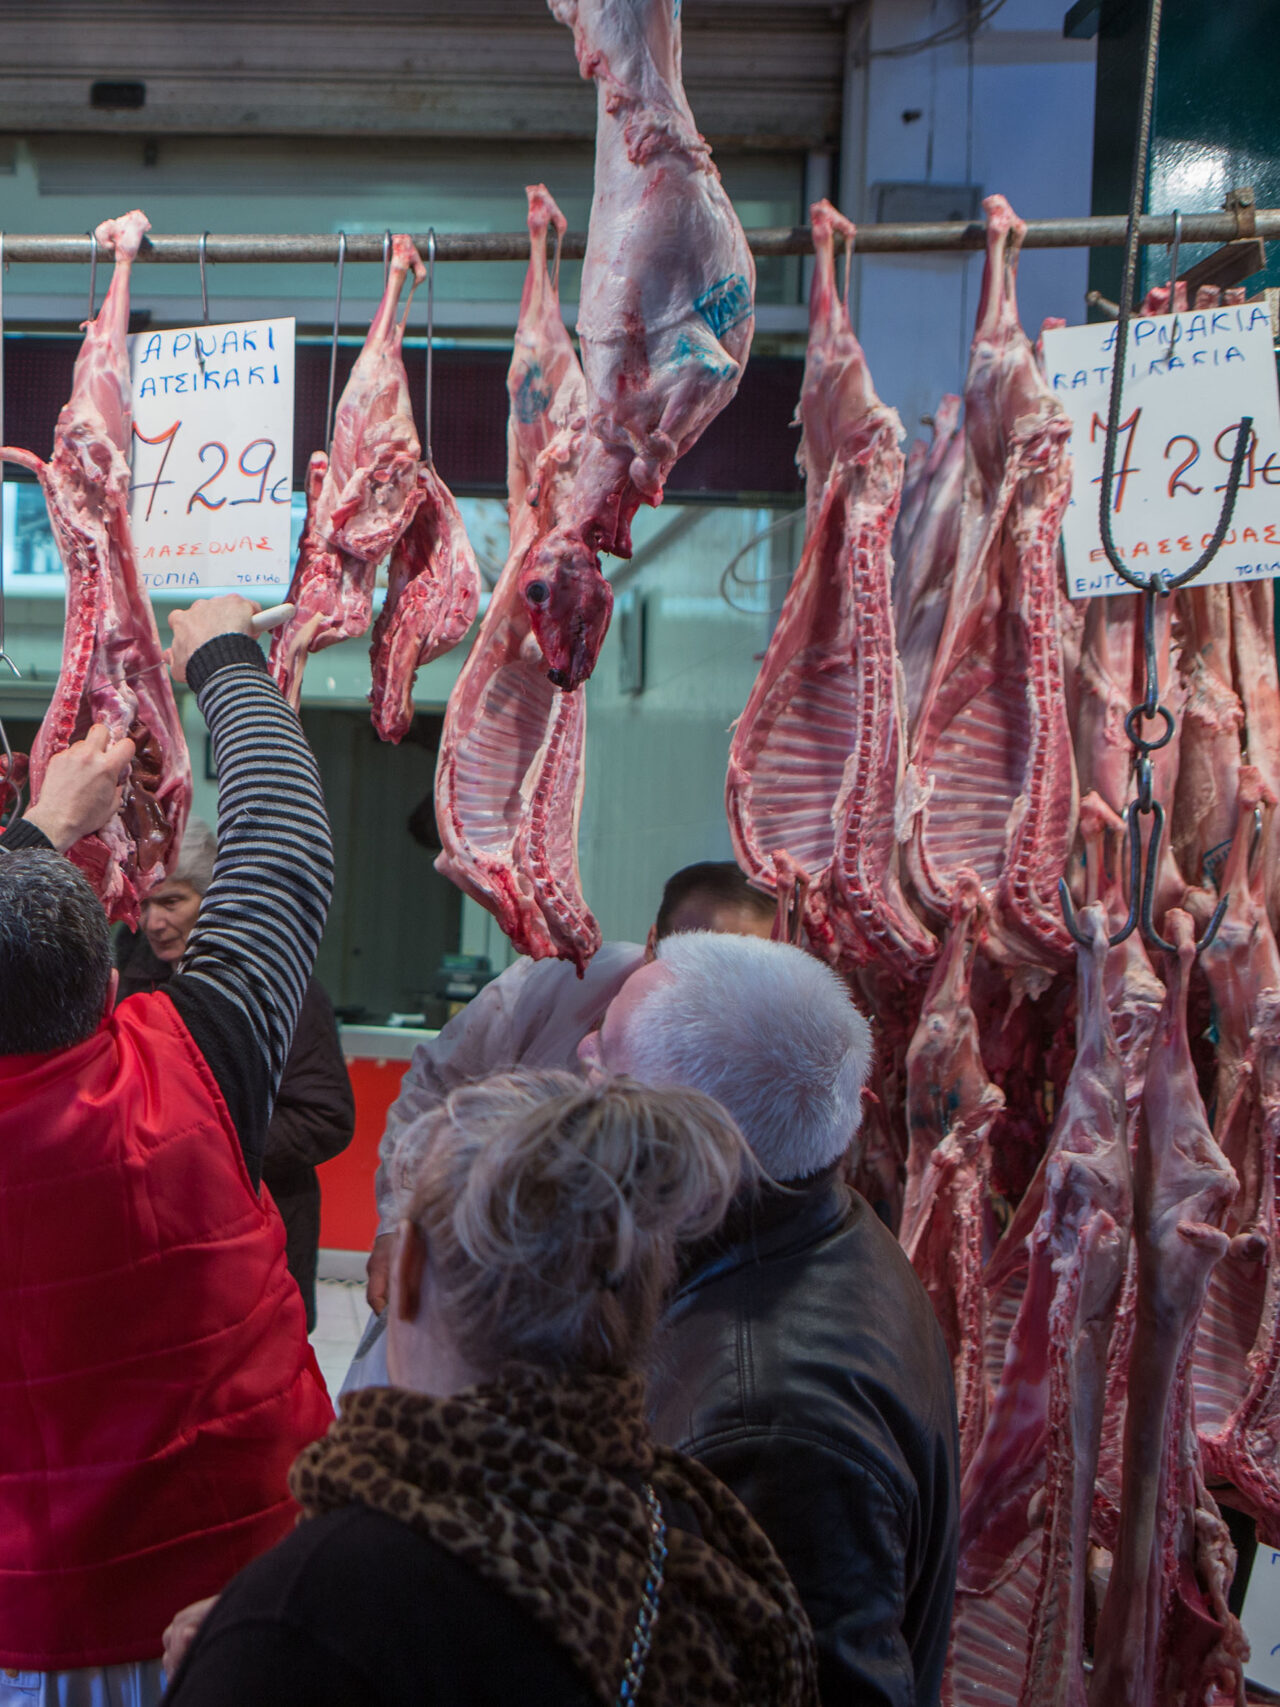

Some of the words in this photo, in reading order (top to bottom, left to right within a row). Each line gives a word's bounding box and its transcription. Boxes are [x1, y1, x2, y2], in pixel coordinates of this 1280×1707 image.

[130, 364, 280, 397] ΑΤΣΙΚΑΚΙ
[1053, 346, 1245, 390] ΚΑΤΙΚΑΚΙΑ
[142, 571, 200, 587] ΤΟΠΙΑ
[1076, 568, 1175, 592] ΕΝΤΟΠΑ
